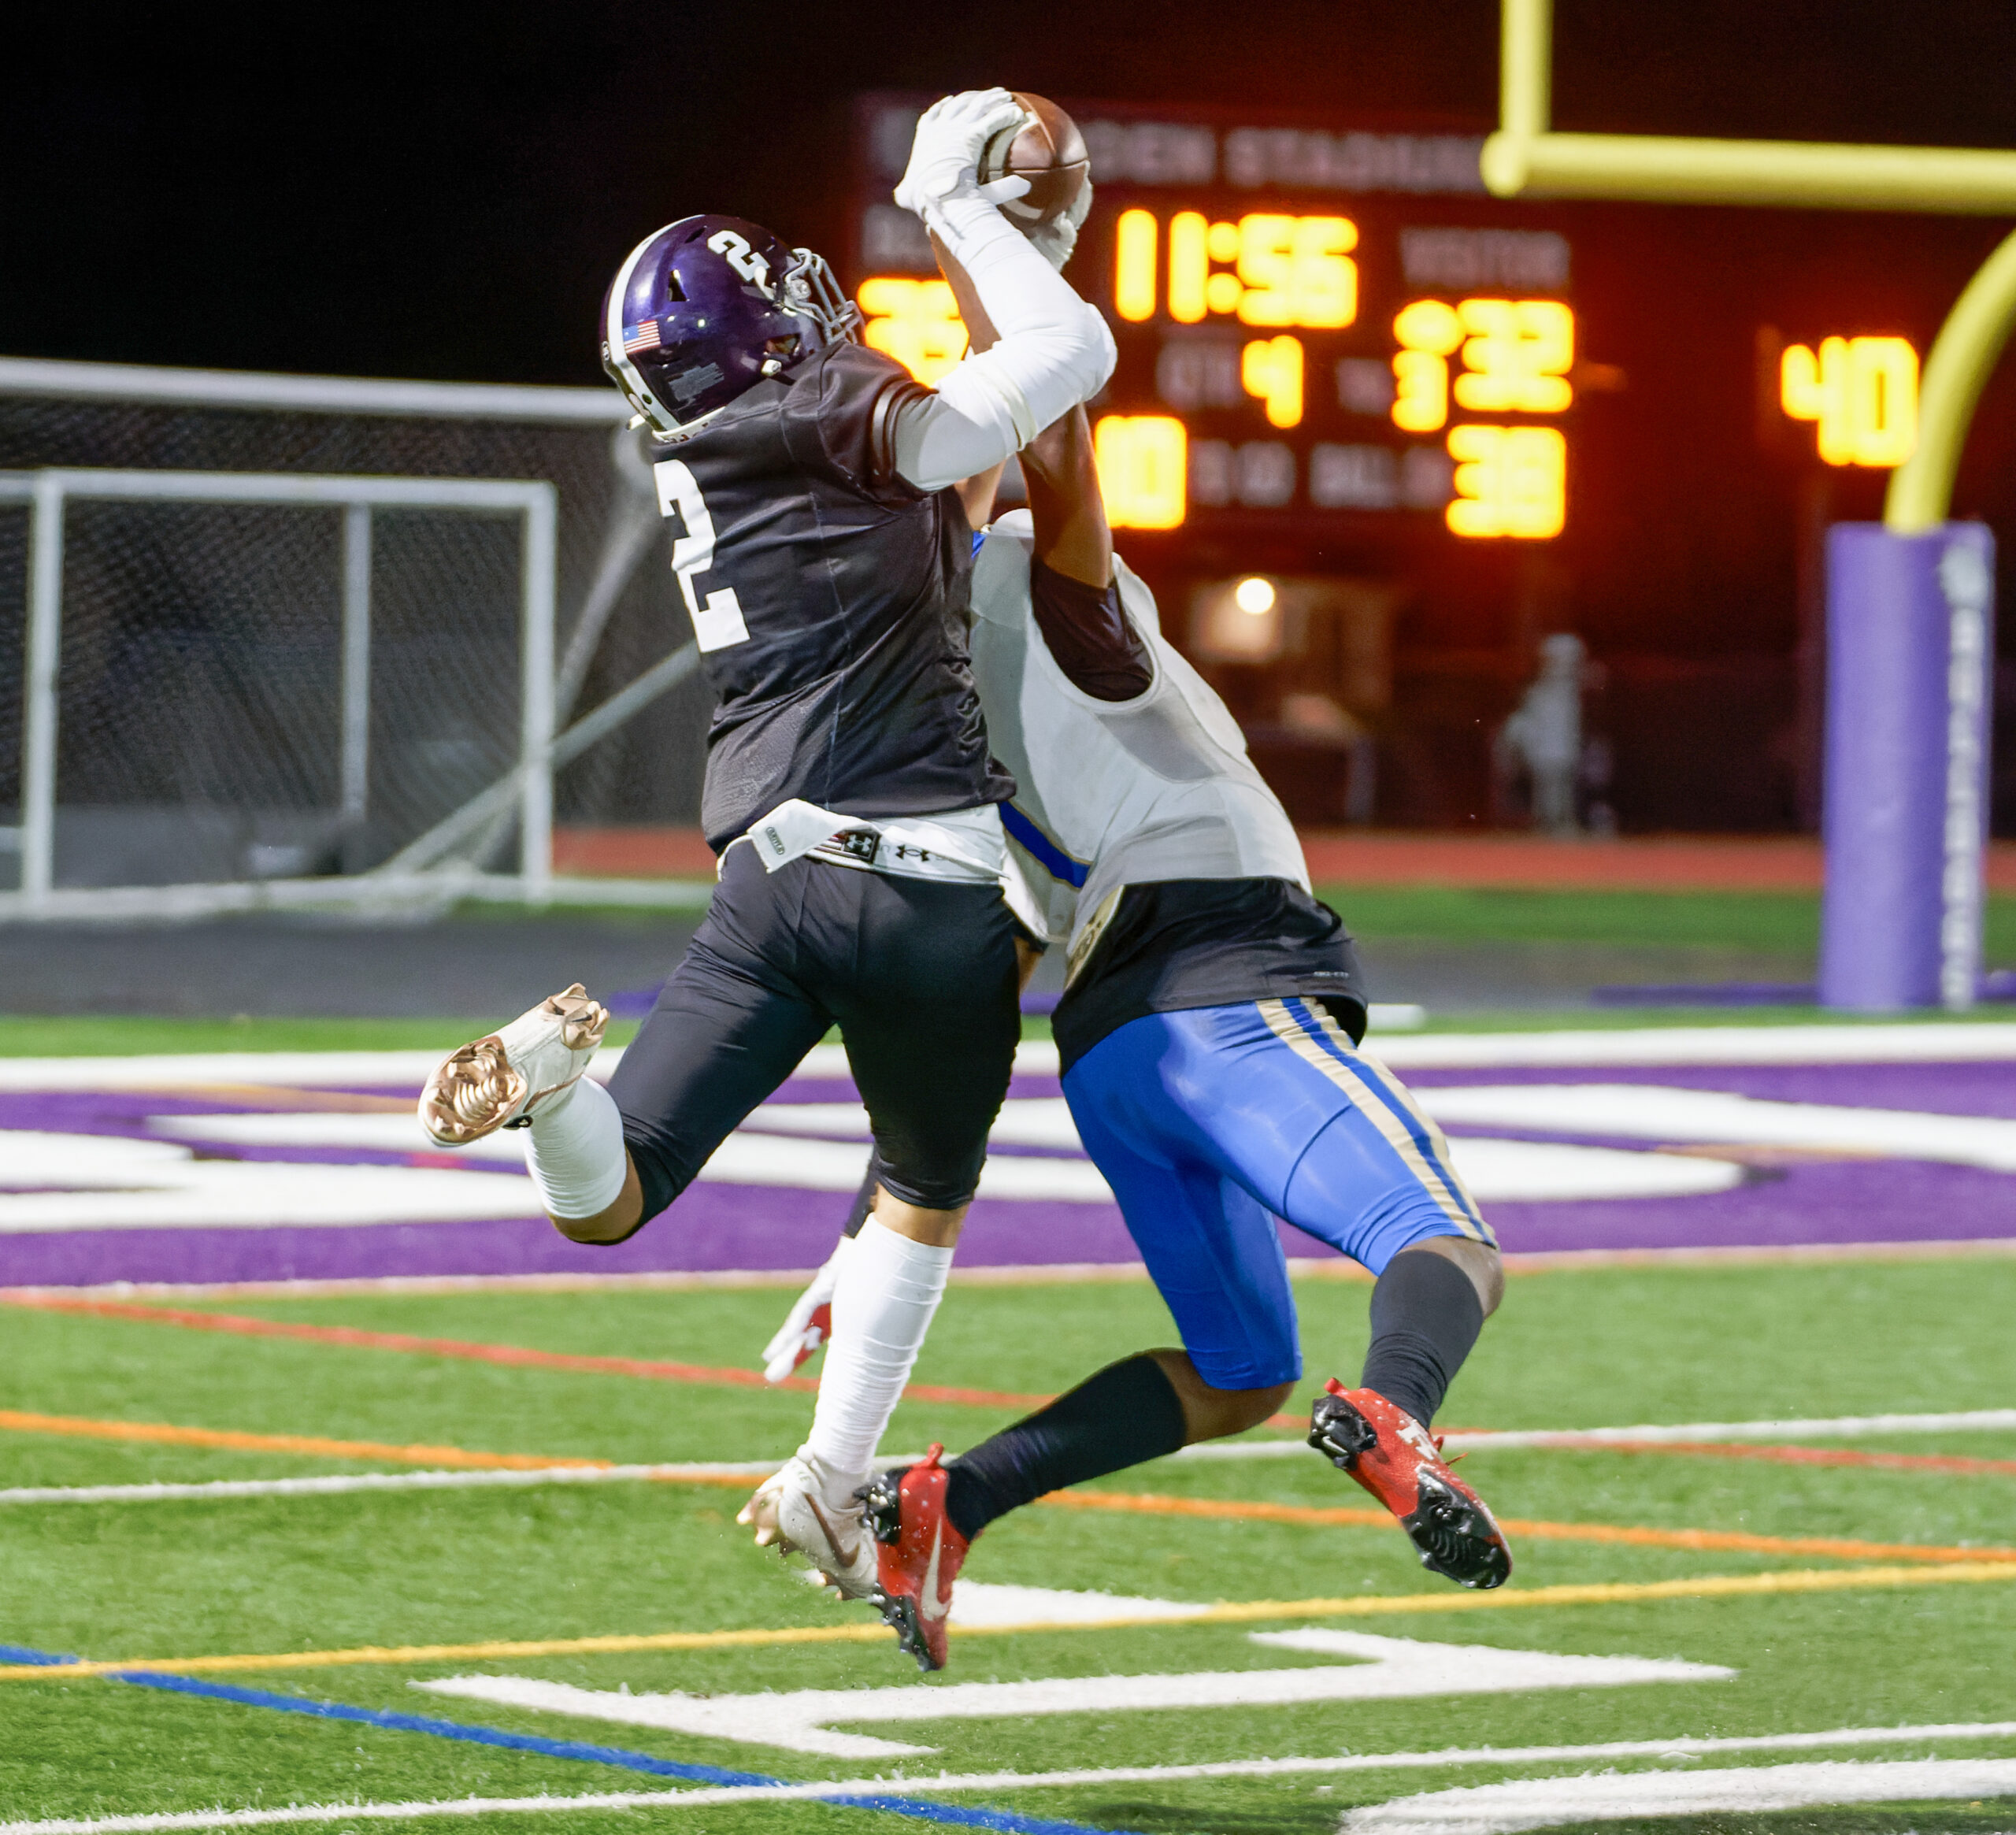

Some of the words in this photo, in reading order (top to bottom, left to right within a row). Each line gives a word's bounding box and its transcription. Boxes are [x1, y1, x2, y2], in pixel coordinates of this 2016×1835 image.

[707, 230, 771, 281] 2
[1243, 337, 1303, 427] 4
[1781, 337, 1918, 466] 40
[654, 458, 750, 653] 2
